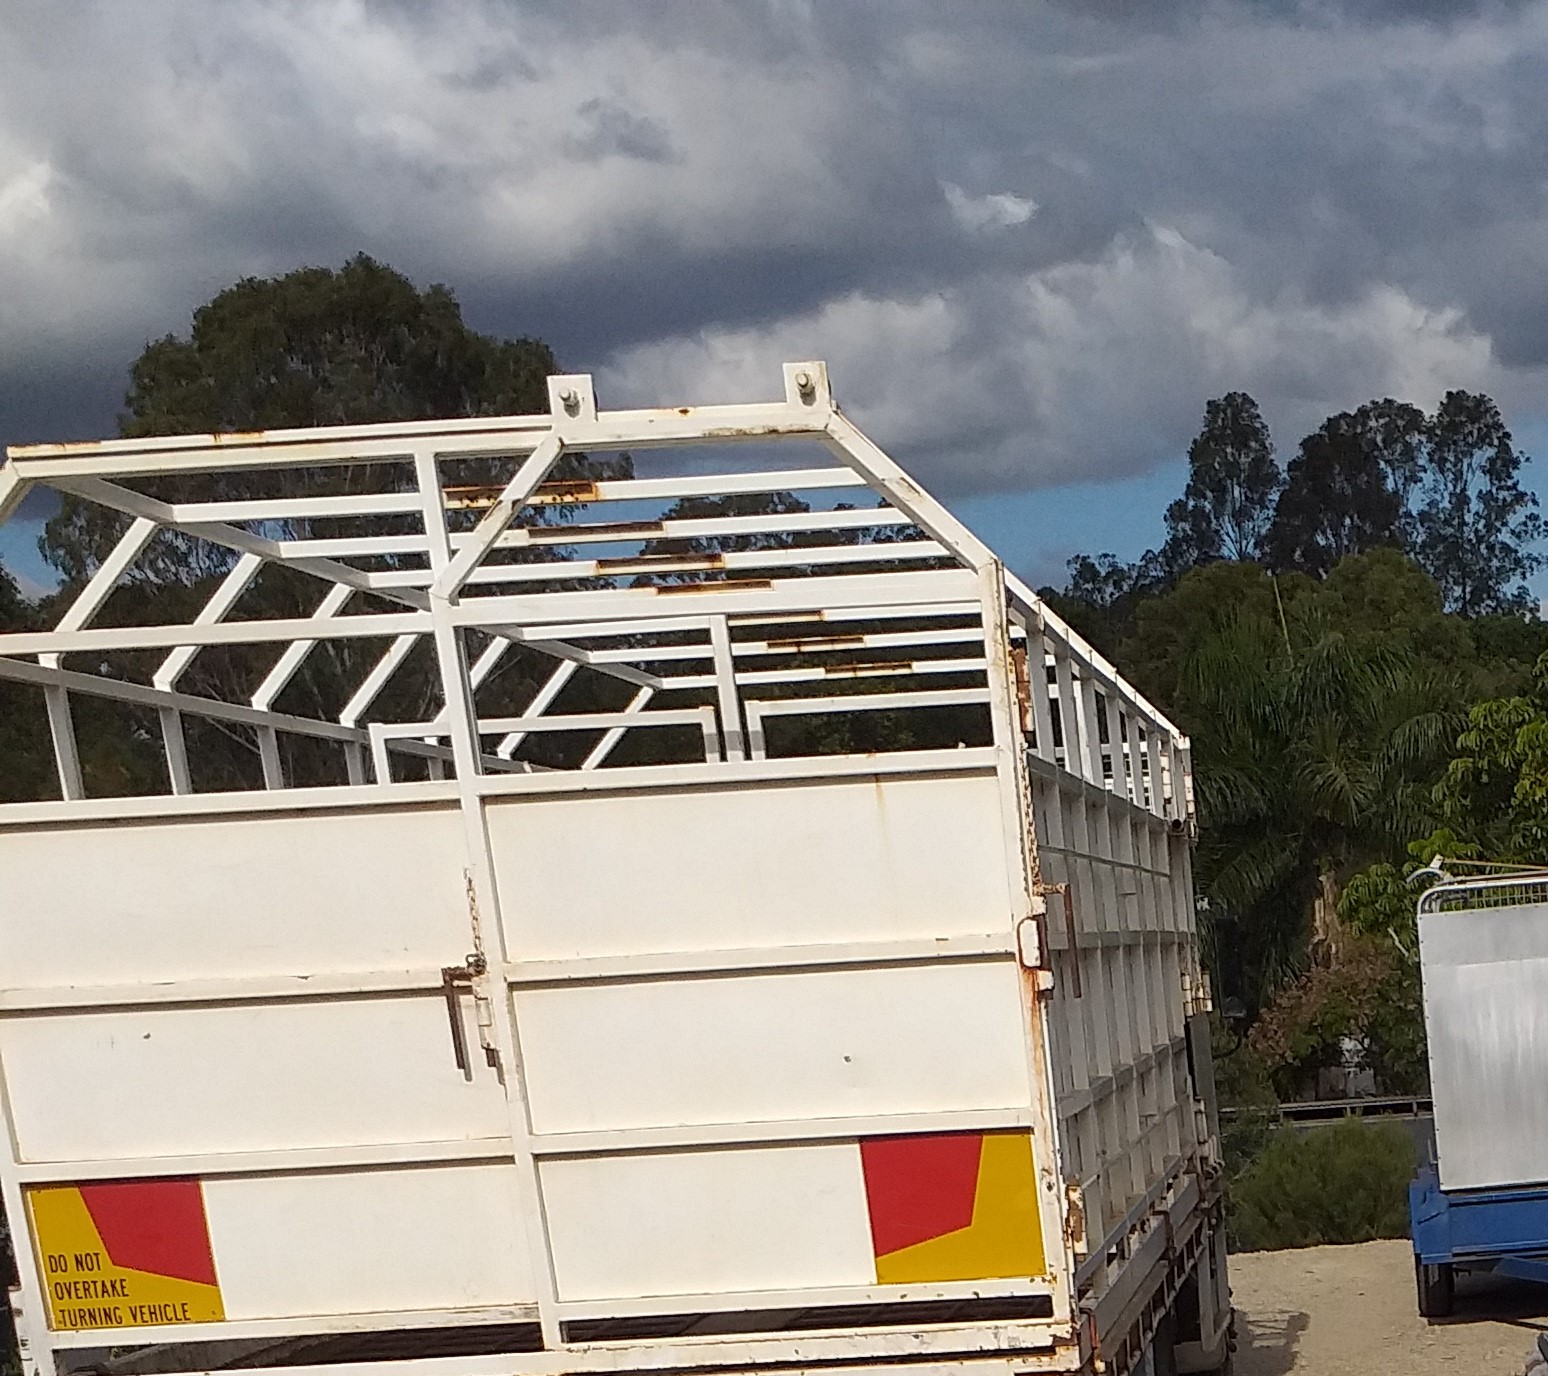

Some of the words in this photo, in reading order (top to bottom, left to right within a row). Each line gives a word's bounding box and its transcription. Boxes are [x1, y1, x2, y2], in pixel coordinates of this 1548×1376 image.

[48, 1254, 68, 1273] DO
[74, 1252, 101, 1272] NOT
[54, 1279, 129, 1300] OVERTAKE
[59, 1307, 123, 1327] TURNING
[128, 1303, 191, 1323] VEHICLE
